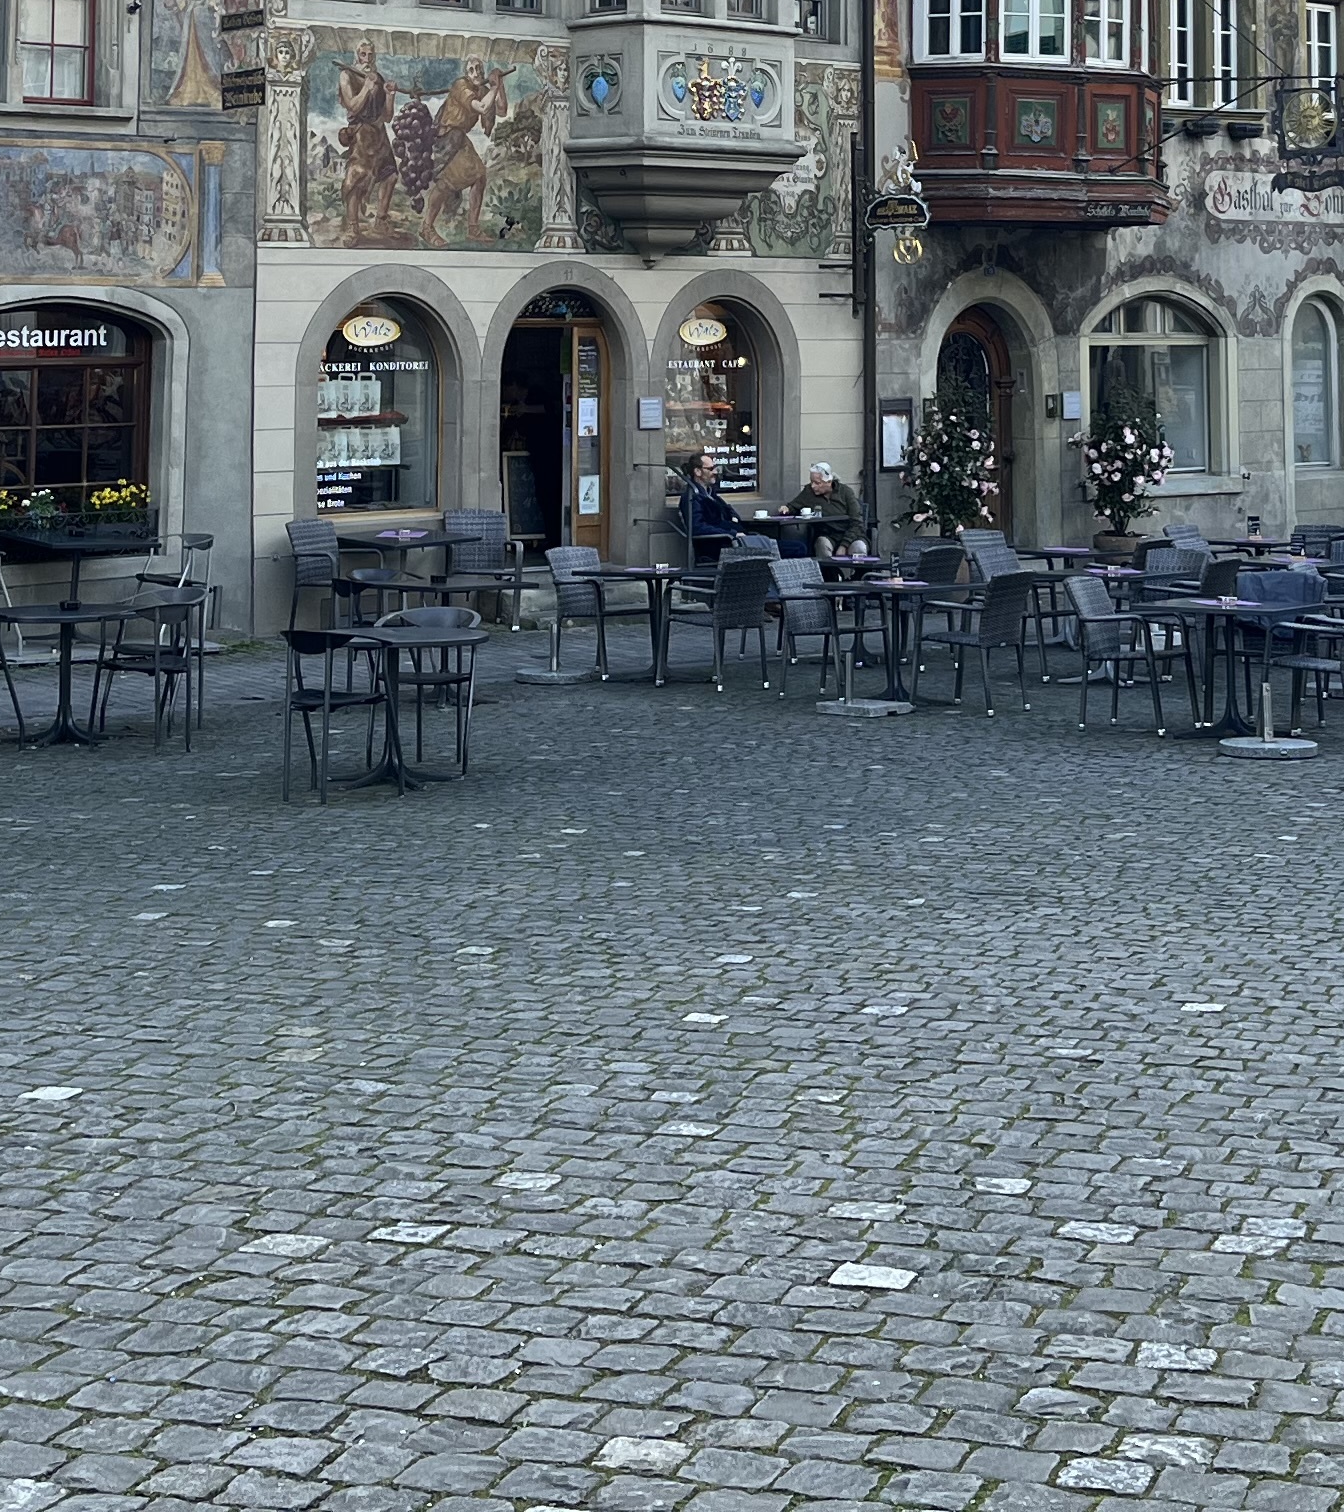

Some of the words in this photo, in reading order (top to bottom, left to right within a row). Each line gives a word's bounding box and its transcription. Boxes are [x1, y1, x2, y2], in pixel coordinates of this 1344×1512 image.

[353, 320, 391, 338] Walz
[319, 361, 361, 372] ÄCKEREI
[369, 361, 429, 371] KONDITOREI
[668, 359, 715, 368] ESTAURANT
